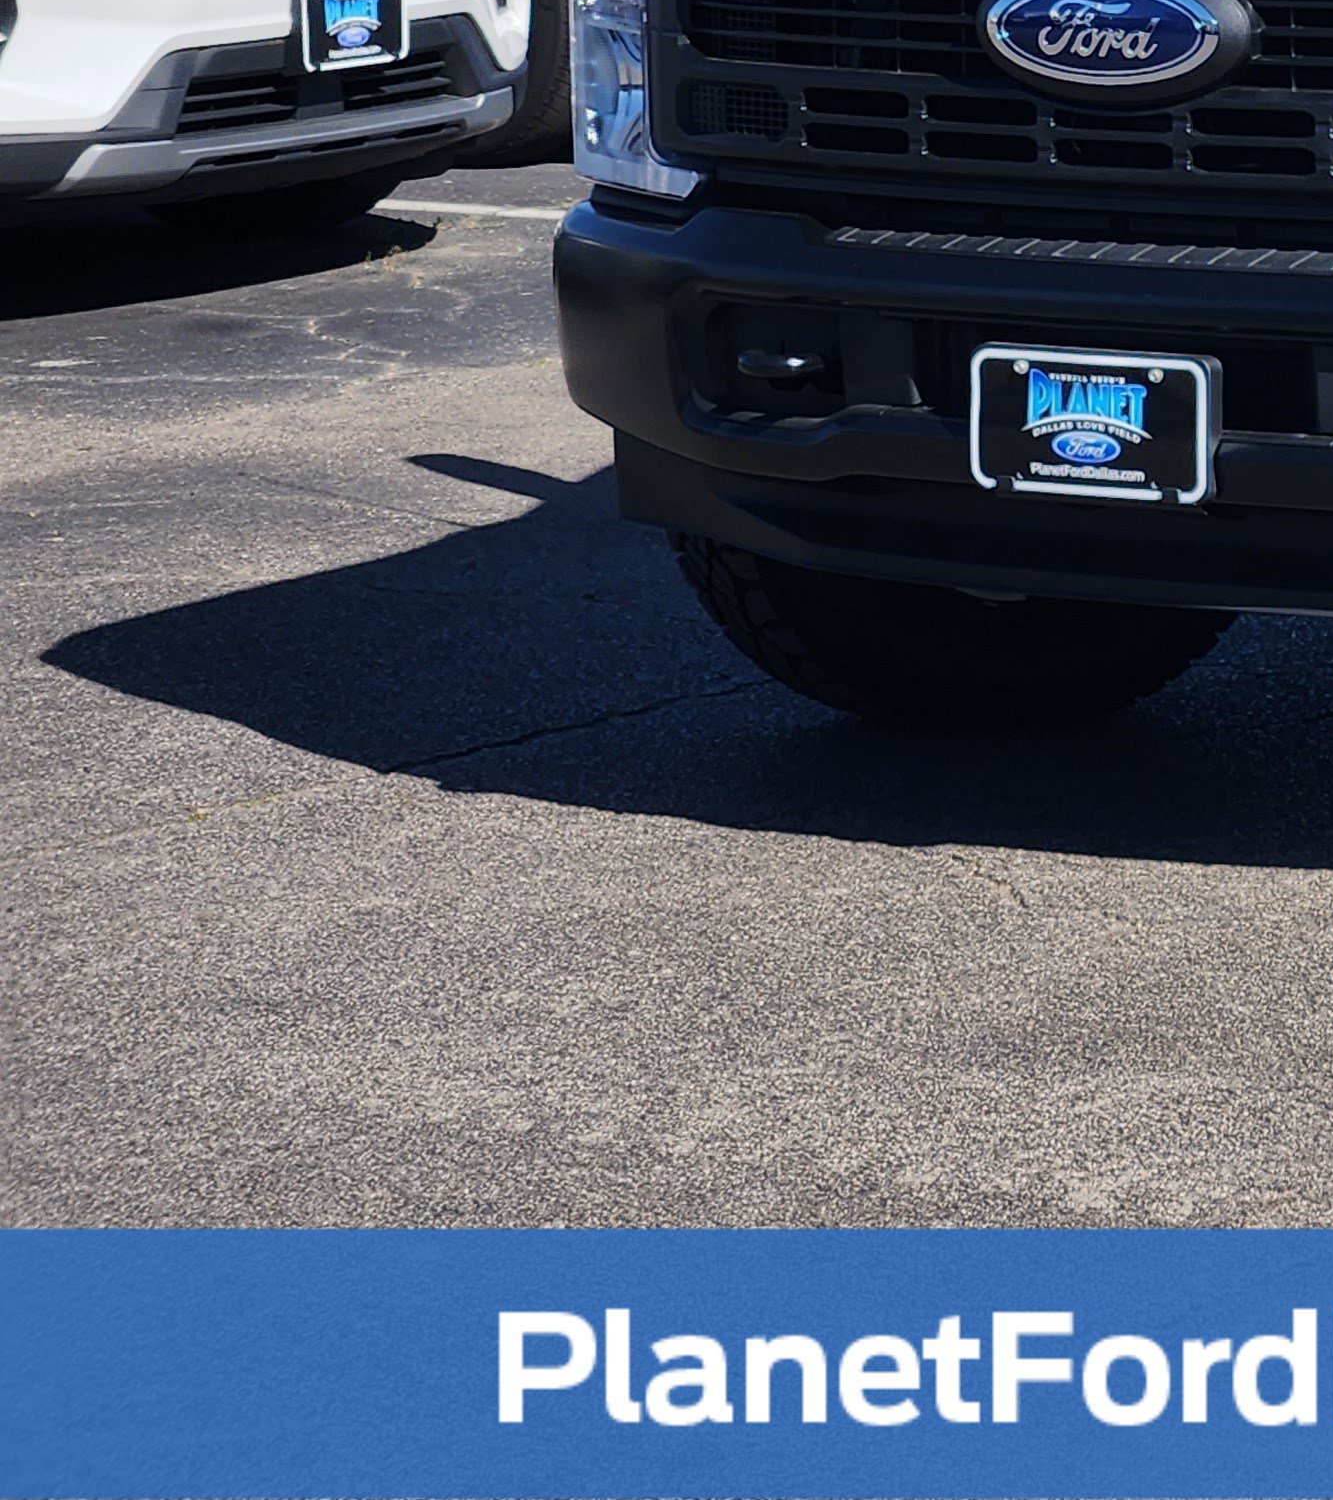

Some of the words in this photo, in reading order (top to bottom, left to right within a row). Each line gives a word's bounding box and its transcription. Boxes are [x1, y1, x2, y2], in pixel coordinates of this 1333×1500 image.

[1027, 368, 1147, 429] PLANET
[1032, 421, 1074, 438] DALLAS
[1076, 421, 1106, 432] LOVE
[1107, 425, 1142, 444] FIELD
[1066, 437, 1107, 458] Ford
[1029, 462, 1146, 482] PlanetFordDallas.com
